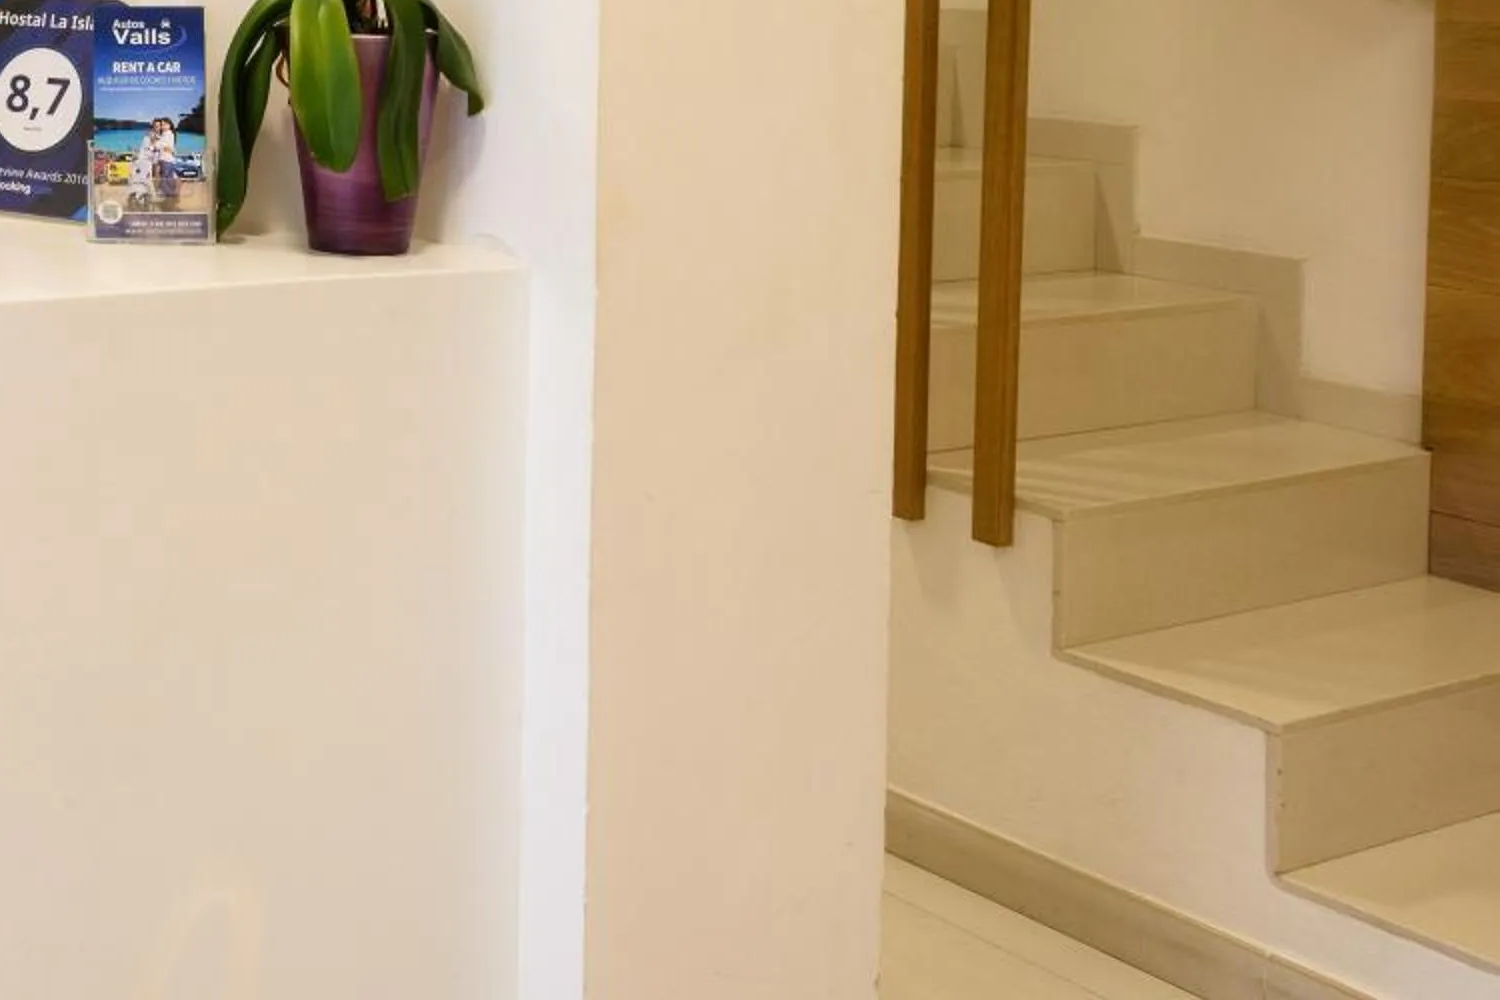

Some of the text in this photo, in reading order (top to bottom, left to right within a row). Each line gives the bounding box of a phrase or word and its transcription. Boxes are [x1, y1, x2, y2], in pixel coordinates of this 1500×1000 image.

[50, 14, 70, 29] La
[112, 19, 145, 29] Autos
[113, 28, 171, 45] Valls
[112, 62, 181, 73] RENT A CAR
[6, 74, 71, 121] 8,7
[26, 168, 62, 183] Awards
